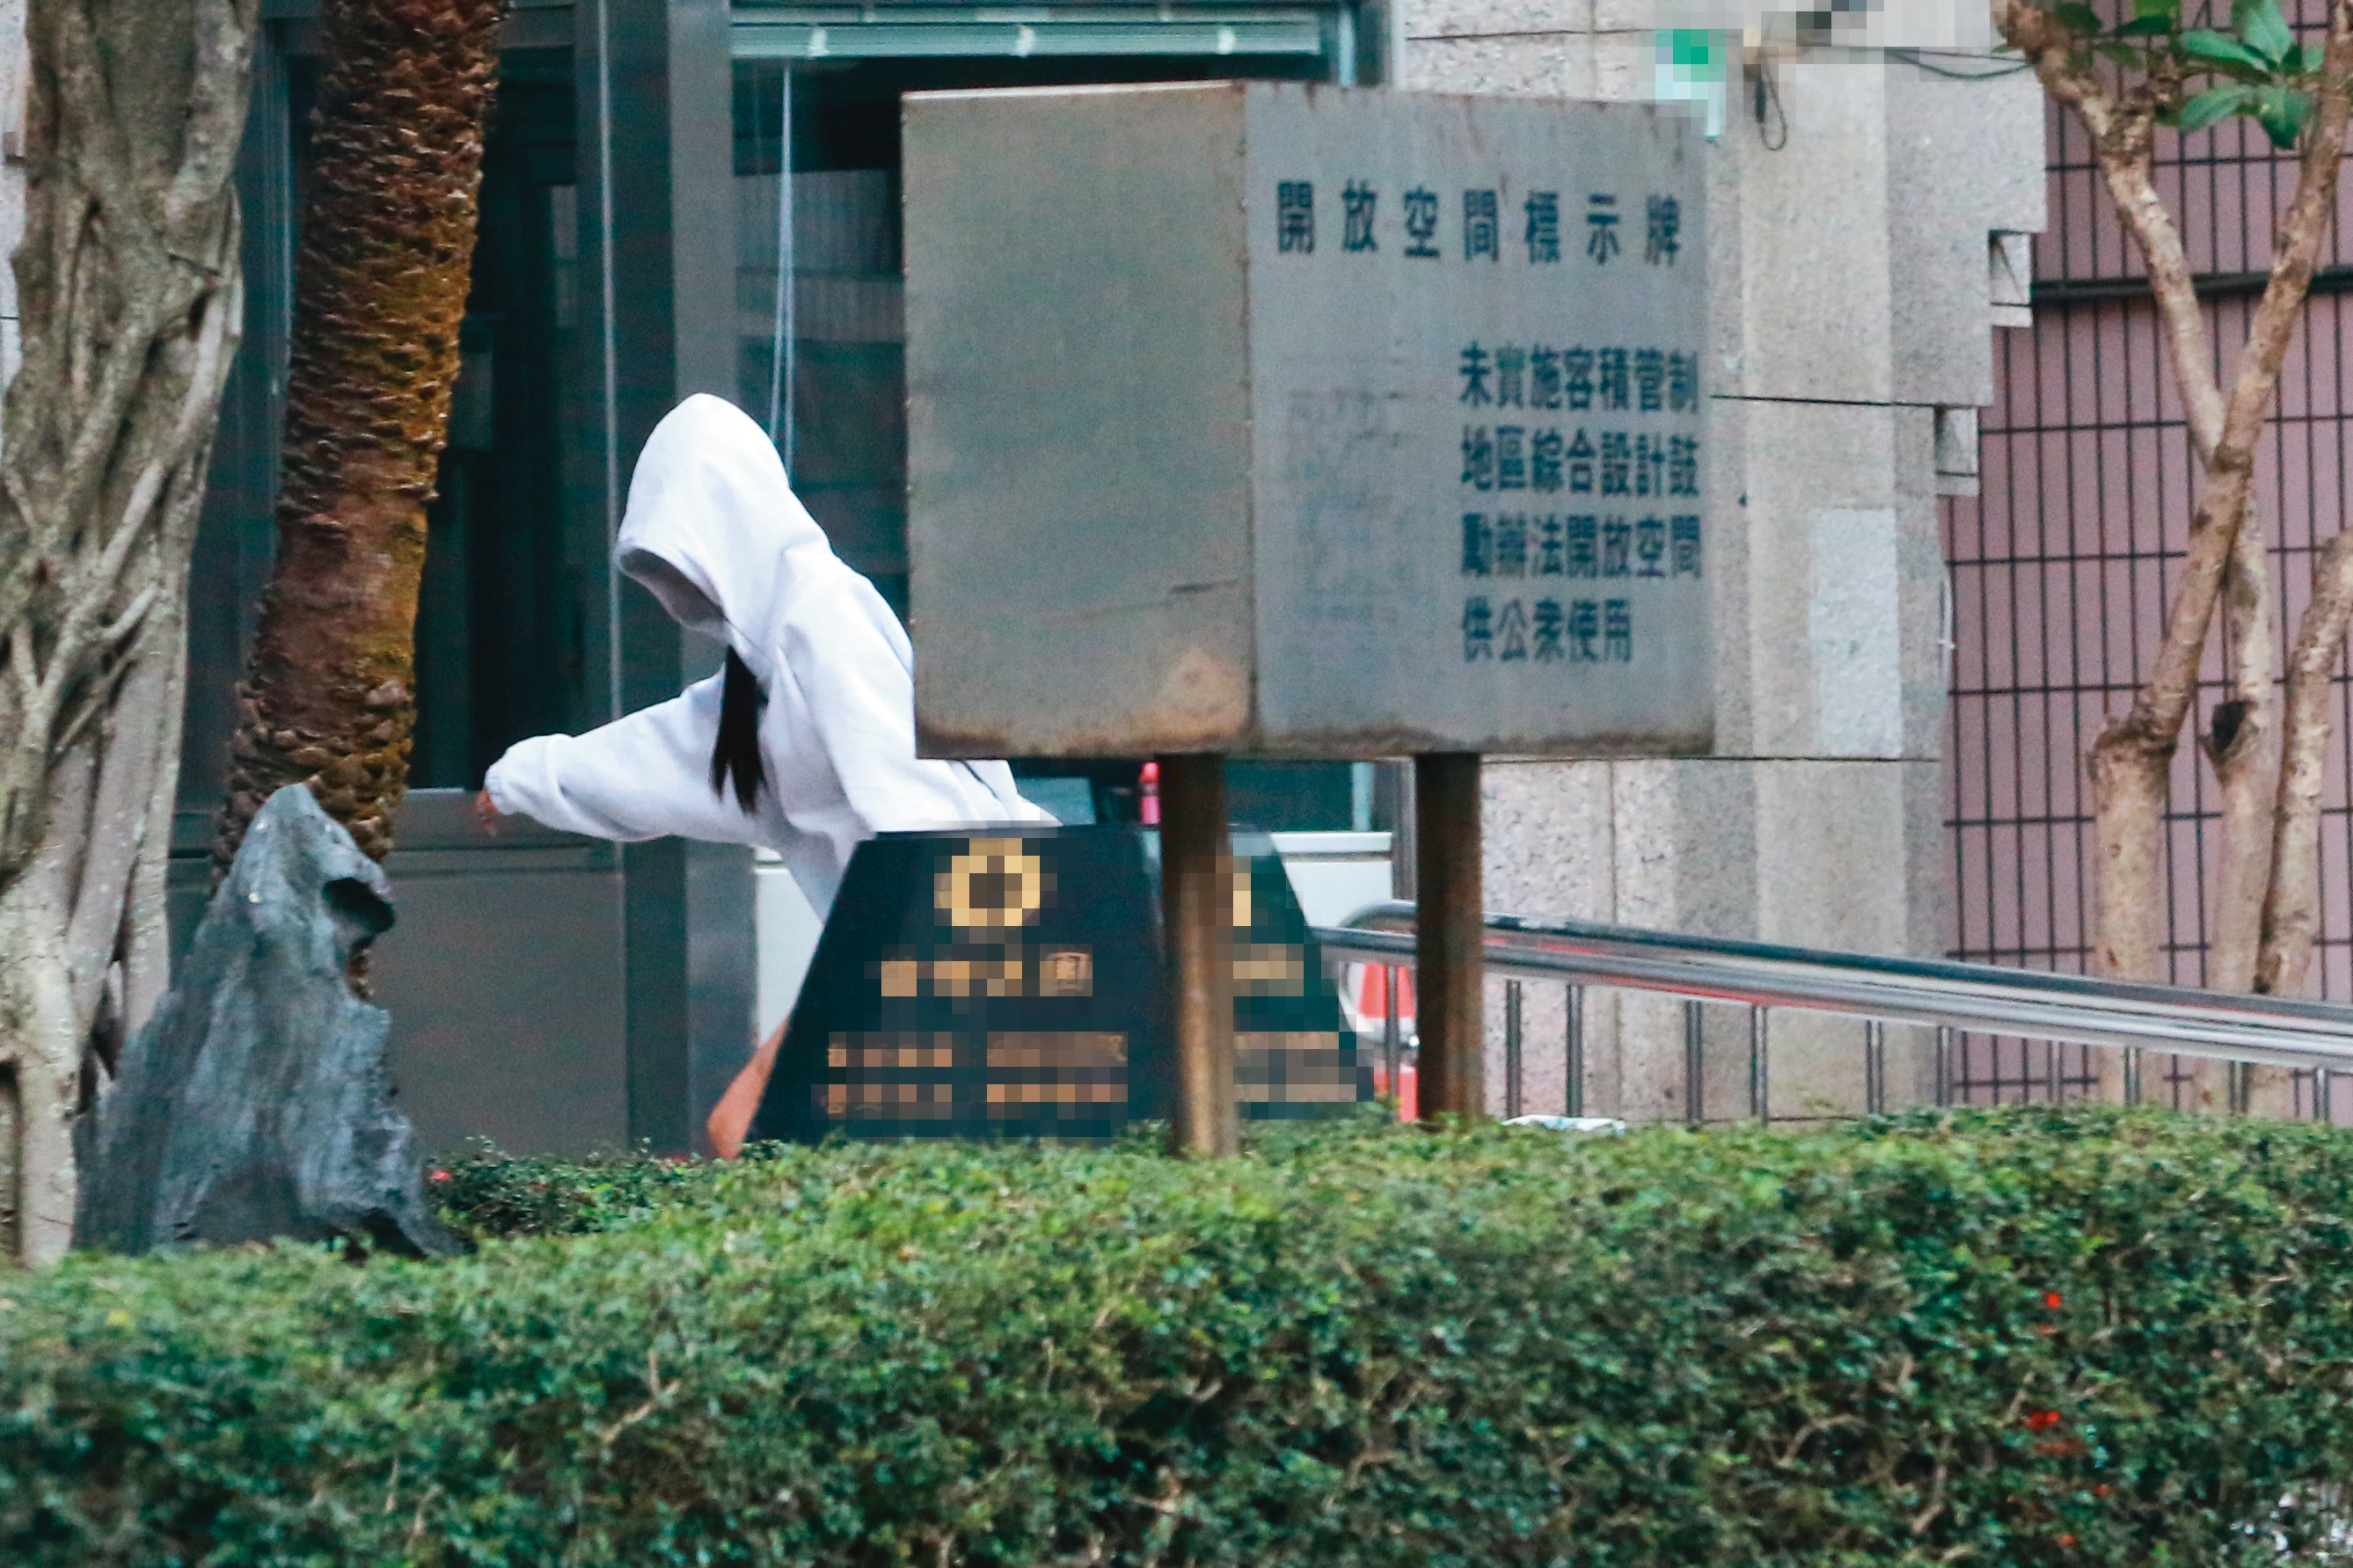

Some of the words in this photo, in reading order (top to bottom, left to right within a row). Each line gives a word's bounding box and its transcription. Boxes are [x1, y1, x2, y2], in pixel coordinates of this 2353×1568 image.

[1276, 179, 1681, 265] 開放空間標示牌
